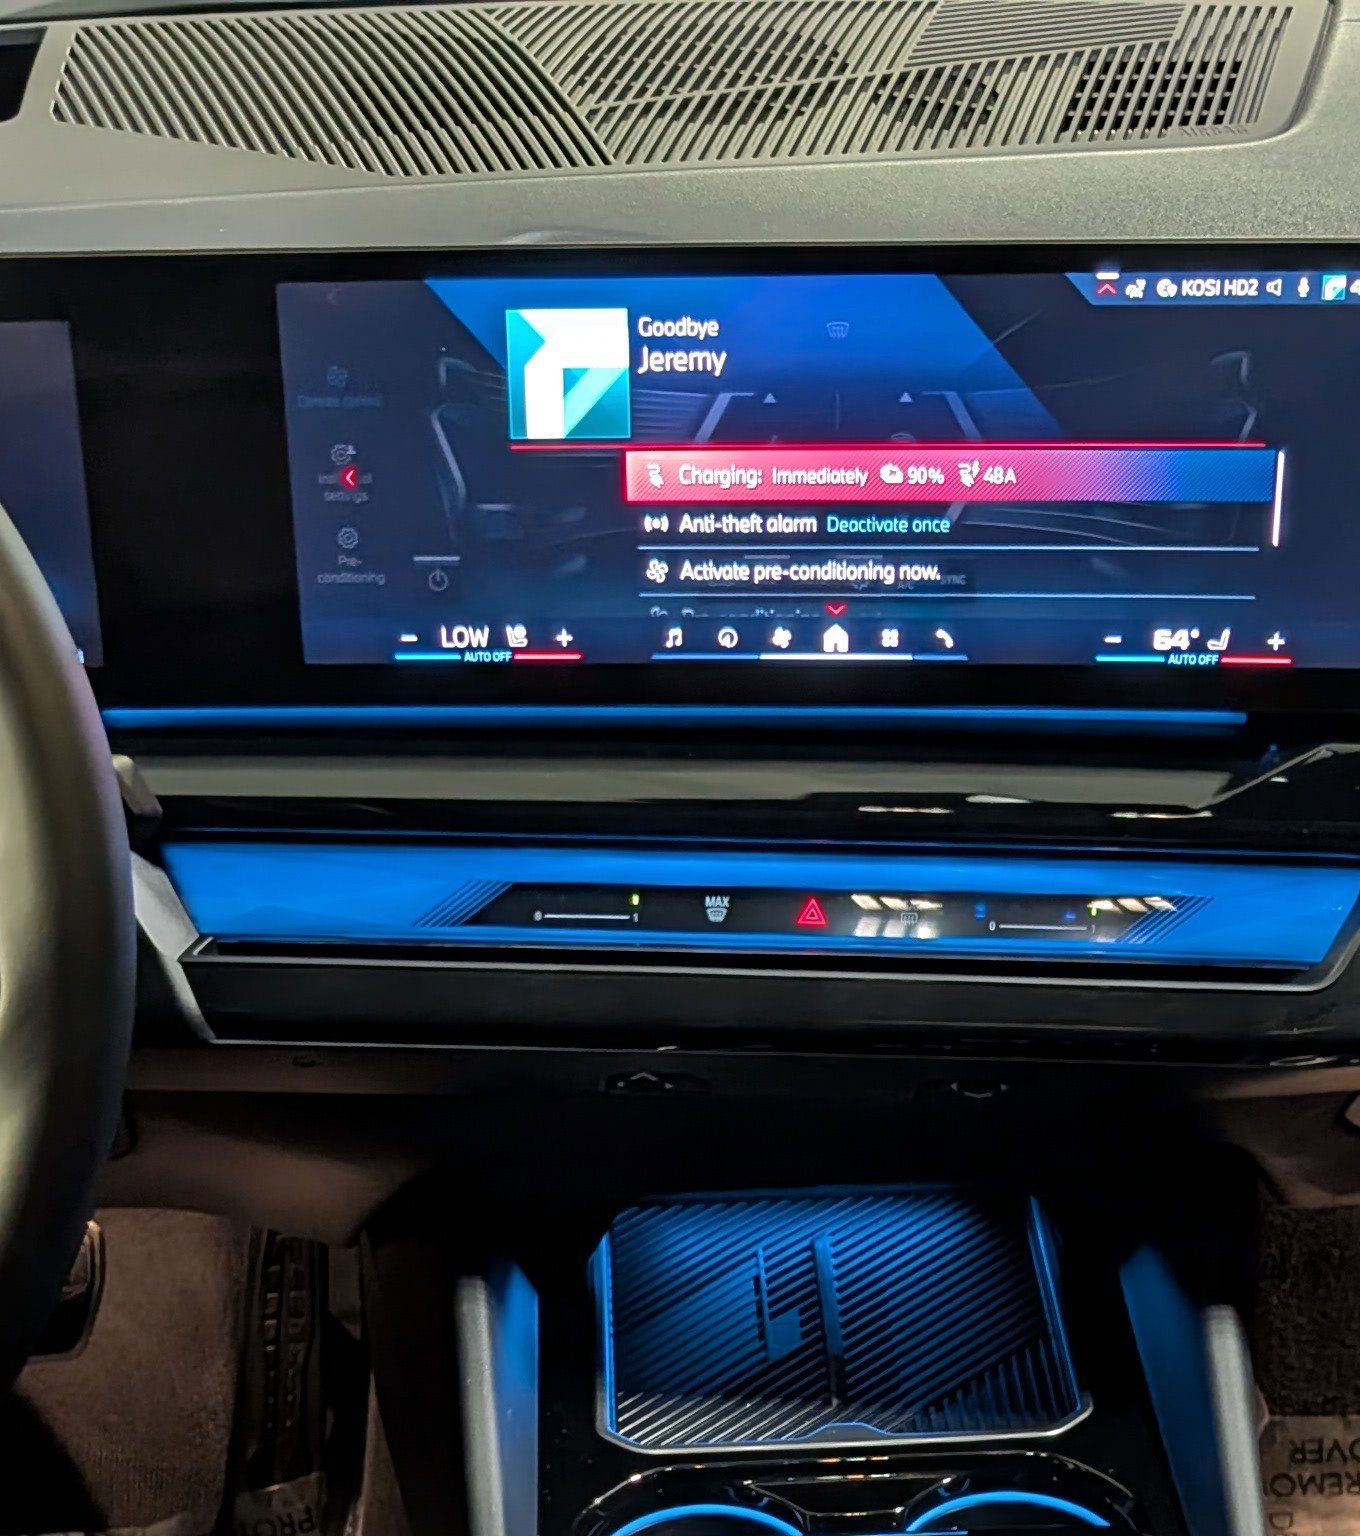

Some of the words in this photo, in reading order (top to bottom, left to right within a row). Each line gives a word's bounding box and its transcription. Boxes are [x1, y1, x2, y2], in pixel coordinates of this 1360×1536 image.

[1223, 278, 1259, 297] HD2
[638, 315, 720, 341] Goodbye
[637, 344, 727, 377] Jeremy
[678, 463, 764, 489] Charging:
[771, 466, 869, 488] Immediately
[906, 465, 946, 485] 90%
[983, 465, 1018, 485] 48A
[679, 512, 763, 534] Anti-theft
[766, 513, 818, 534] alarm
[826, 514, 909, 534] Deactivate
[911, 517, 951, 534] once
[679, 559, 750, 581] Activate
[753, 559, 896, 585] pre-conditioning
[898, 563, 942, 581] now.
[440, 624, 490, 649] LOW
[463, 650, 490, 663] AUTO
[492, 650, 513, 663] OFF
[1167, 653, 1197, 666] AUTO
[1198, 653, 1220, 666] OFF
[704, 895, 731, 908] MAX
